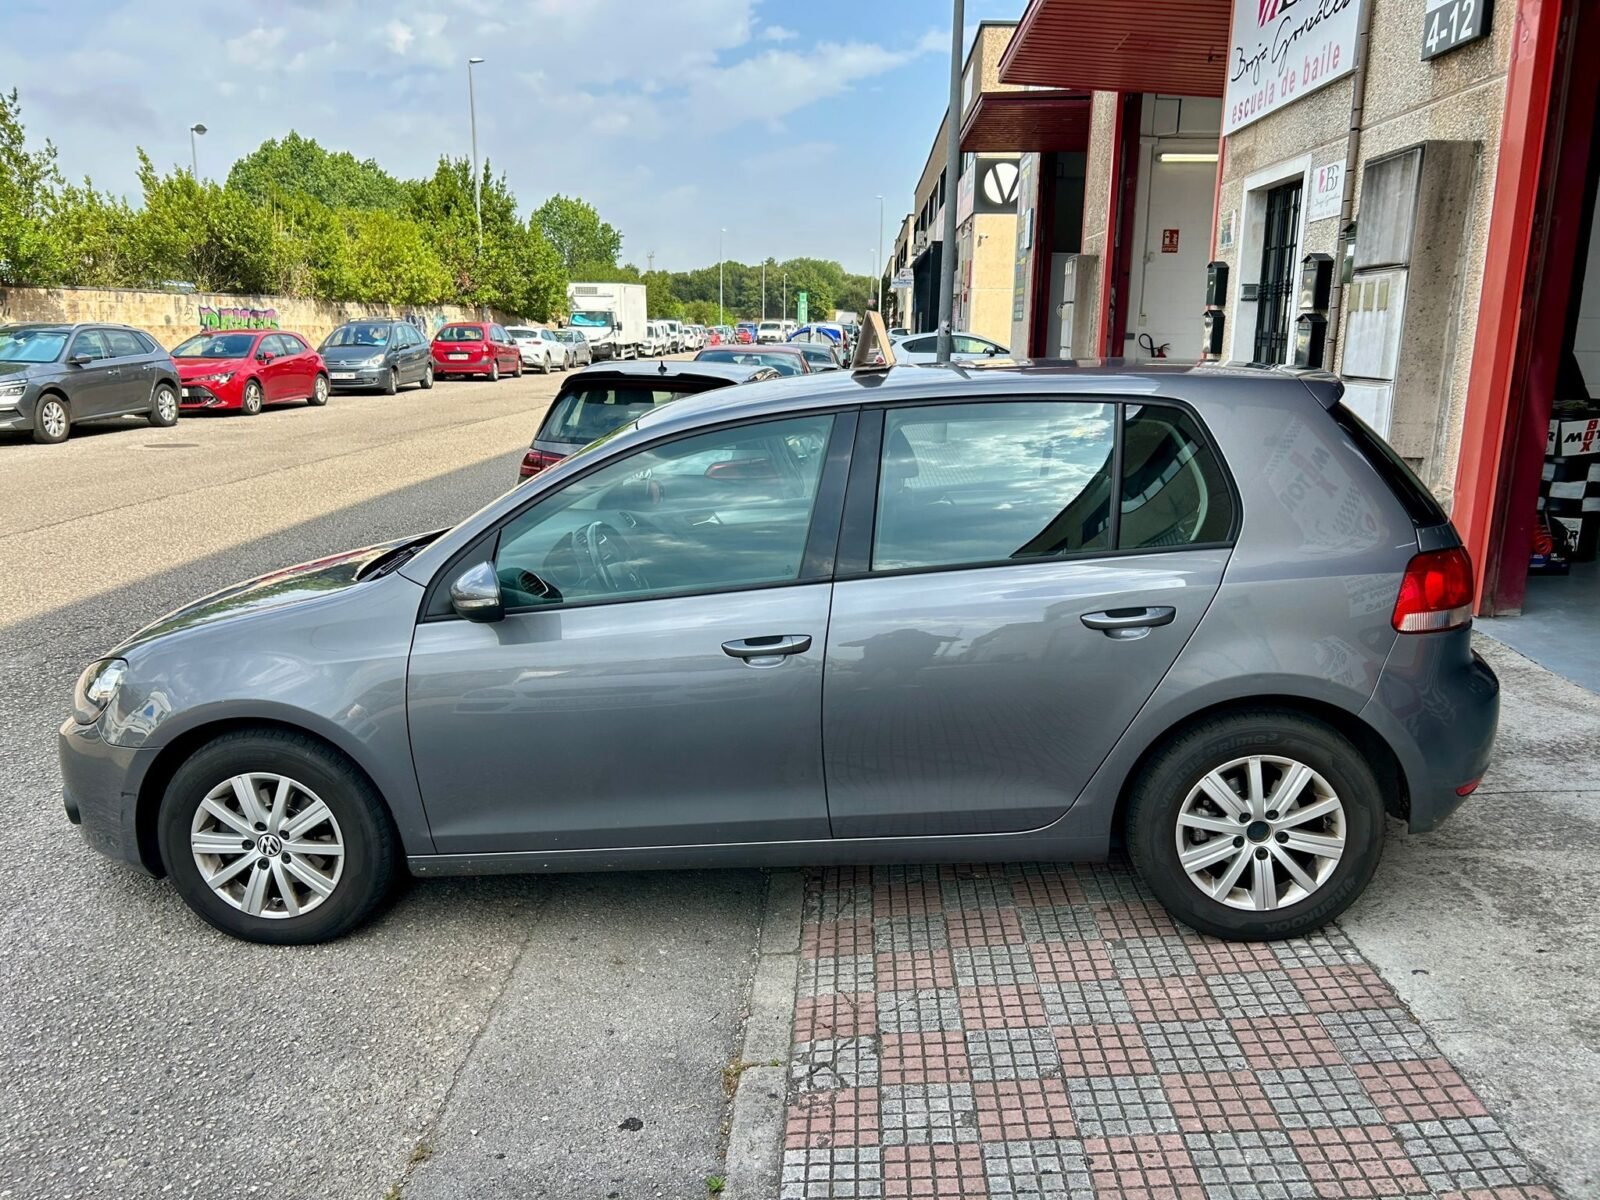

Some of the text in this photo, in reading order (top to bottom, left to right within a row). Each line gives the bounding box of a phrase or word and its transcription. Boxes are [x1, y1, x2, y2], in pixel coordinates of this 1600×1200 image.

[1425, 0, 1475, 53] 4-12
[1232, 40, 1341, 124] escuela de baile
